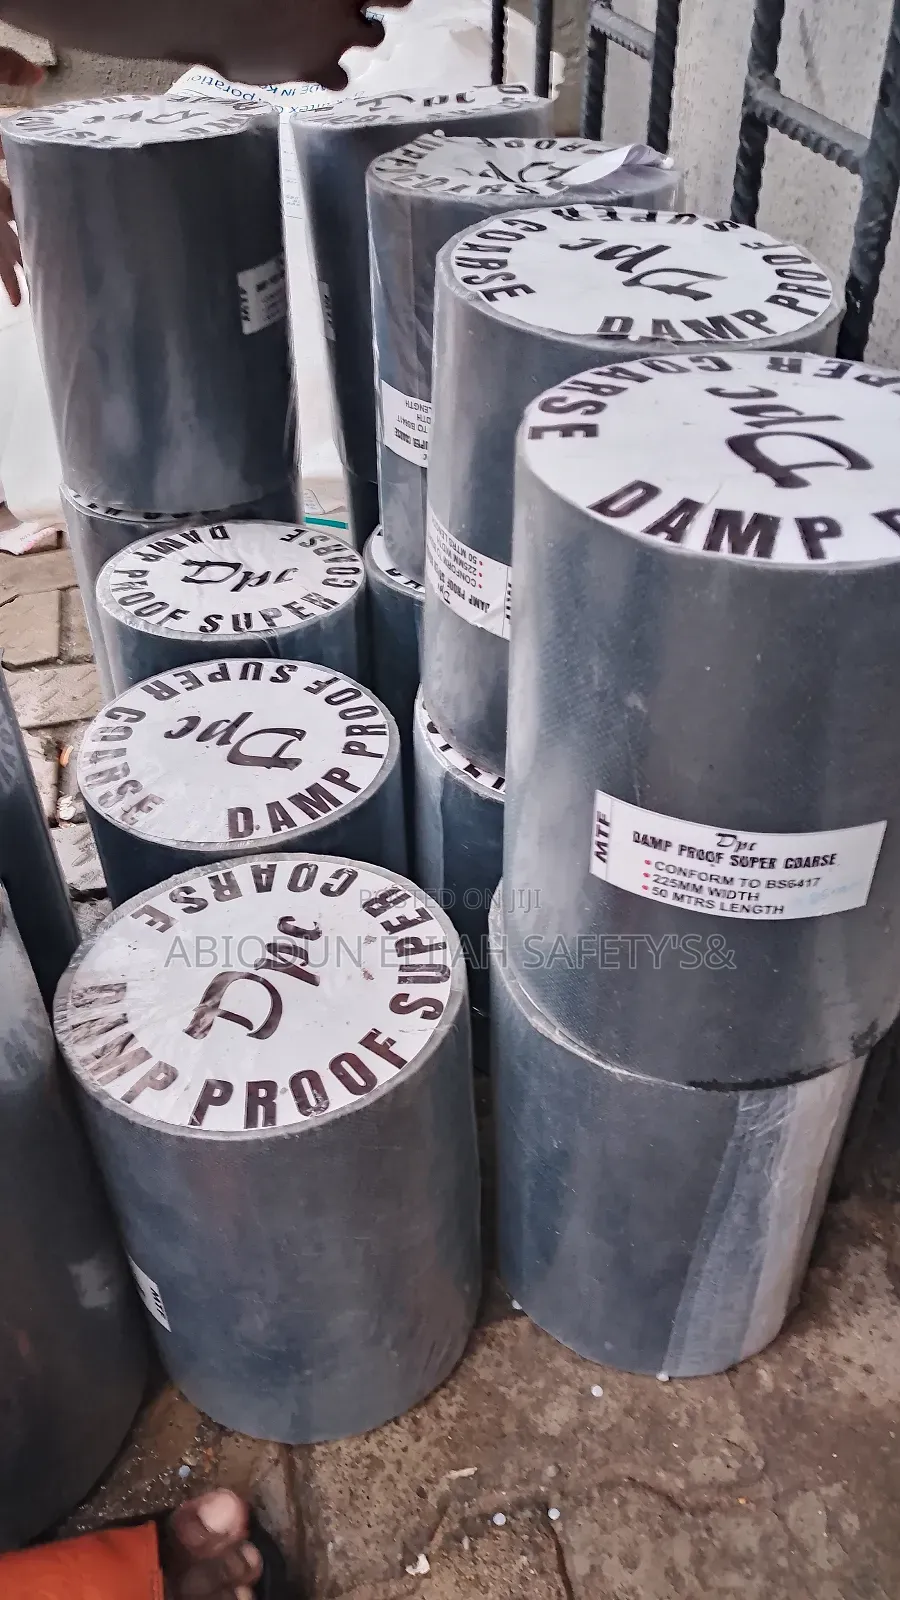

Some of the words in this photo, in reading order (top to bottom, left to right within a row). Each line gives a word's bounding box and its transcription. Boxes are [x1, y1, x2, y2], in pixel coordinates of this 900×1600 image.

[551, 204, 741, 234] SUPER
[454, 217, 548, 303] COARSE
[558, 237, 729, 302] Dpc
[740, 240, 832, 318] PROOF
[596, 308, 778, 344] DAMP
[405, 399, 432, 414] ENGTH
[416, 413, 432, 425] DTH
[527, 354, 733, 440] COARSE
[704, 384, 875, 489] Dpc
[132, 523, 232, 565] DAMP
[585, 478, 844, 560] DAMP
[179, 558, 300, 593] Dpc
[279, 527, 362, 590] COARSE
[468, 555, 478, 565] 50
[110, 567, 192, 627] PROOF
[198, 590, 342, 634] SUPER
[140, 660, 299, 704] SUPER
[163, 710, 308, 771] Dpc
[303, 675, 390, 760] PROOF
[81, 705, 166, 826] COARSE
[227, 765, 362, 840] DAMP
[594, 810, 611, 864] MTF
[632, 830, 673, 853] DAMP
[677, 843, 724, 867] PROOF
[729, 853, 777, 870] SUPER
[784, 852, 838, 870] COARSE
[715, 832, 758, 852] Dpc
[130, 863, 361, 934] COARSE
[651, 886, 669, 899] 50
[671, 890, 716, 909] MTRS
[719, 899, 786, 916] LENGTH
[652, 874, 705, 894] 225MM
[707, 883, 760, 902] WIDTH
[654, 860, 735, 887] CONFORM
[740, 877, 761, 889] TO
[765, 876, 821, 890] BS6417
[183, 915, 324, 1041] Dpc
[361, 888, 452, 1021] SUPER
[67, 981, 180, 1105] DAMP
[186, 1027, 408, 1130] PROOF
